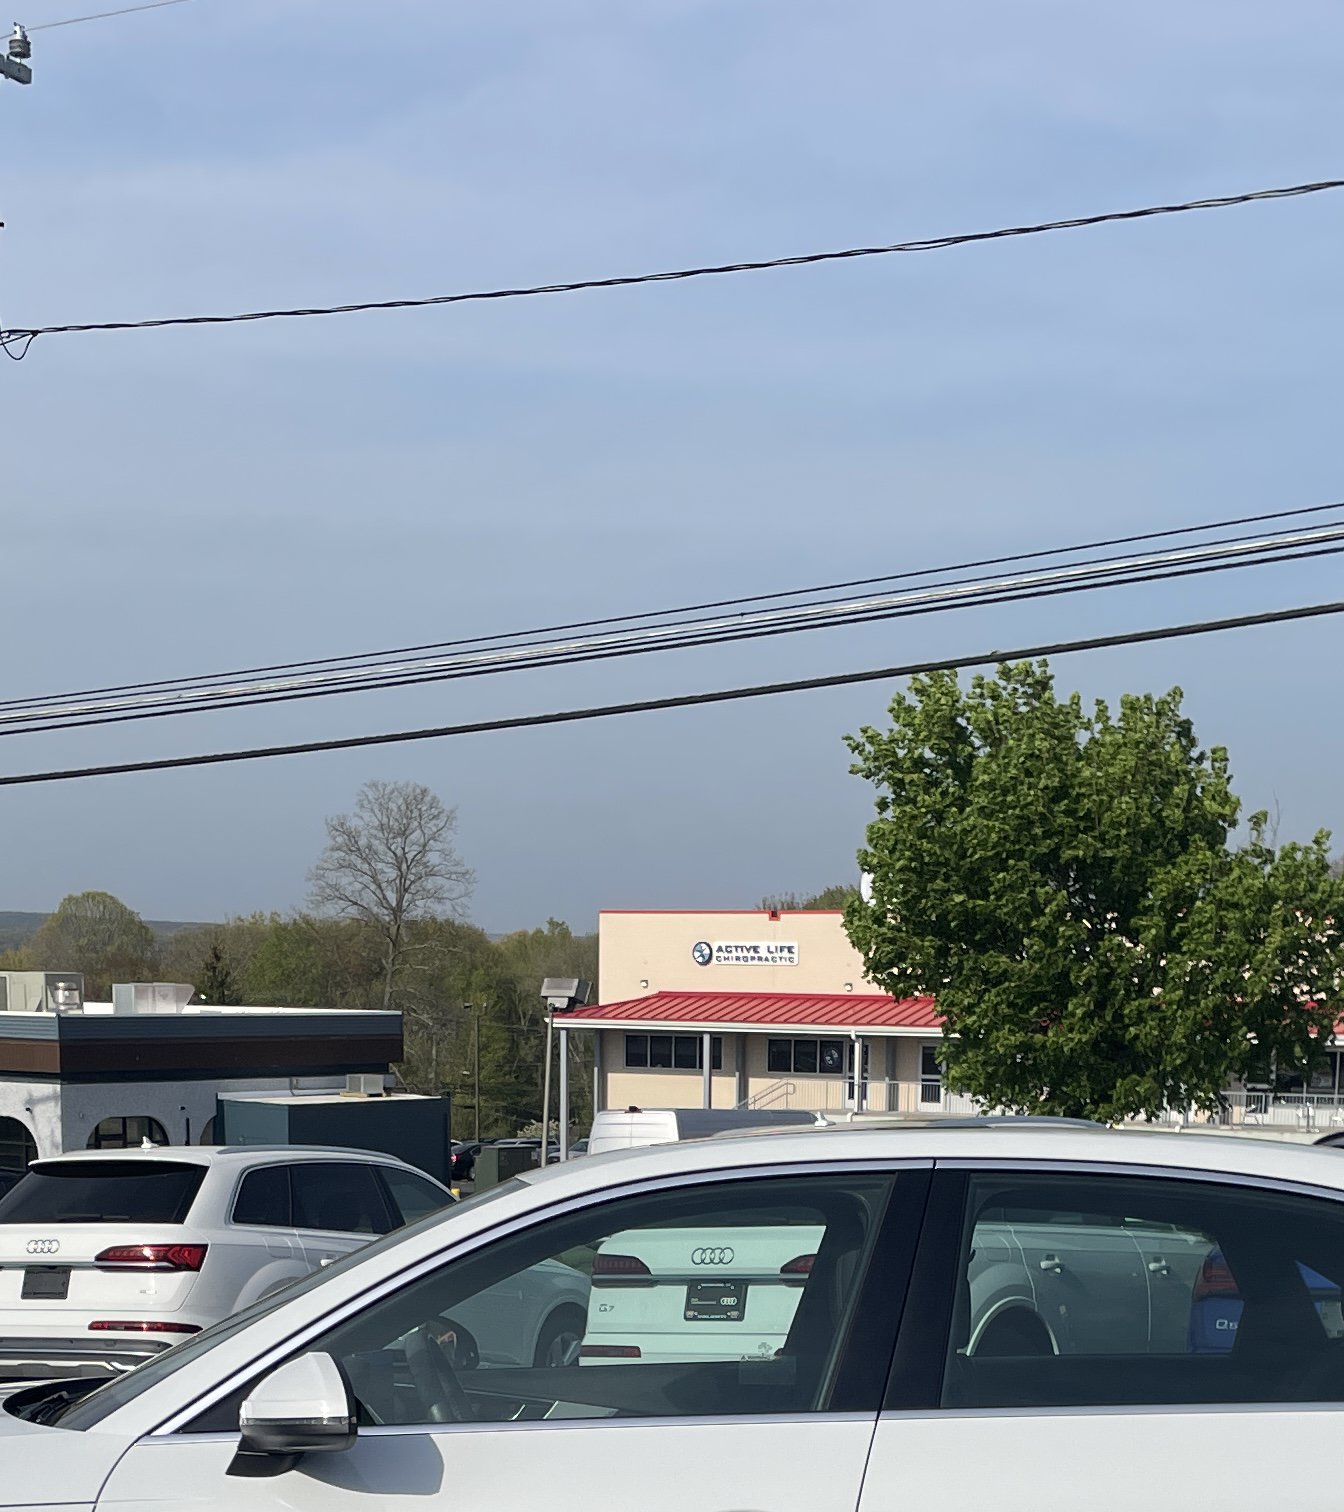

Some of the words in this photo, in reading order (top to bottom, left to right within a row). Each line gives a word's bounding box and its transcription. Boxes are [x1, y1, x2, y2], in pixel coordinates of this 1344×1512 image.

[716, 945, 760, 954] ACTIVE
[767, 945, 795, 954] LIFE
[715, 955, 795, 963] CHIROPRACTIC
